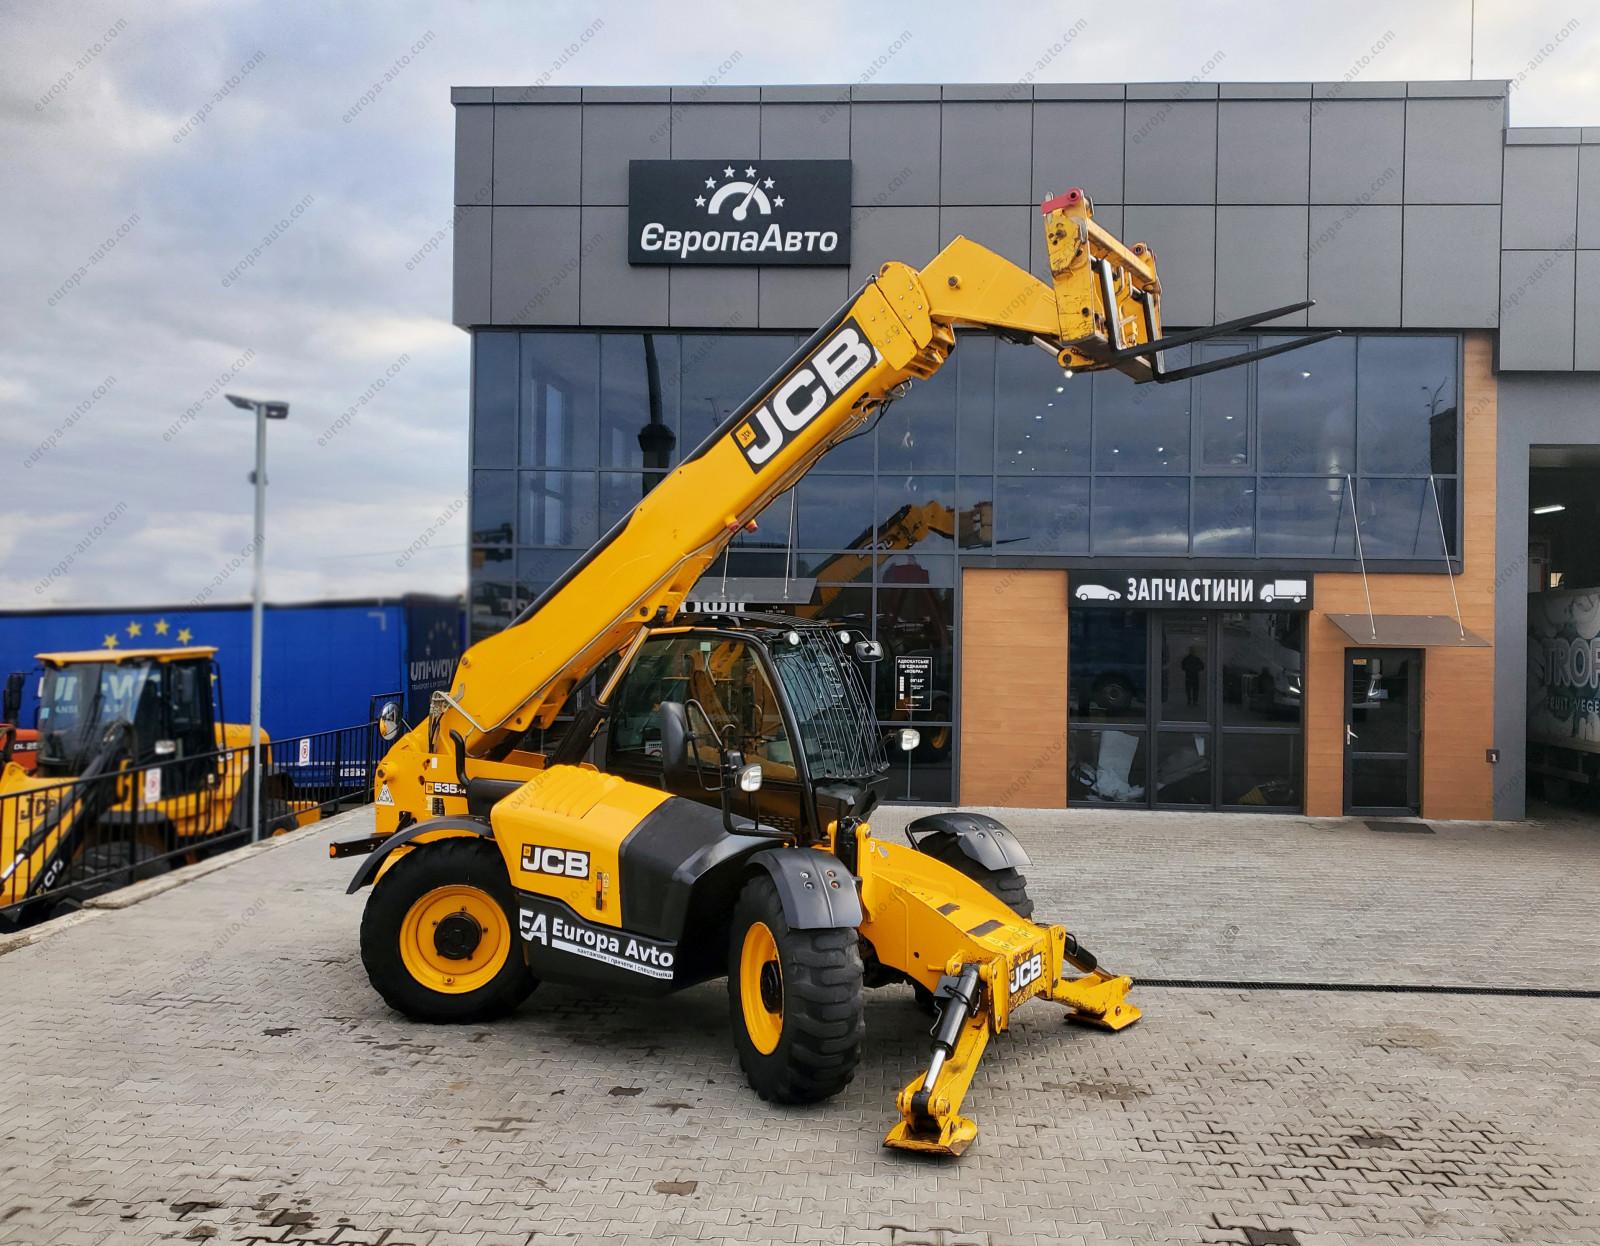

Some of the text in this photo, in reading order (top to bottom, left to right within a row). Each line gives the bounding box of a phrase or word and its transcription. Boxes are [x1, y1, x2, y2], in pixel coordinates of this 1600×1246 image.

[640, 222, 838, 258] ЄвропаАвто
[747, 328, 871, 464] JCB
[1127, 577, 1254, 602] ЗАПЧАСТИНИ
[410, 658, 454, 685] uni-way
[434, 782, 467, 794] 535-14
[522, 847, 589, 878] JCB
[519, 907, 674, 967] EA Europa Avto
[1010, 954, 1041, 993] JCB
